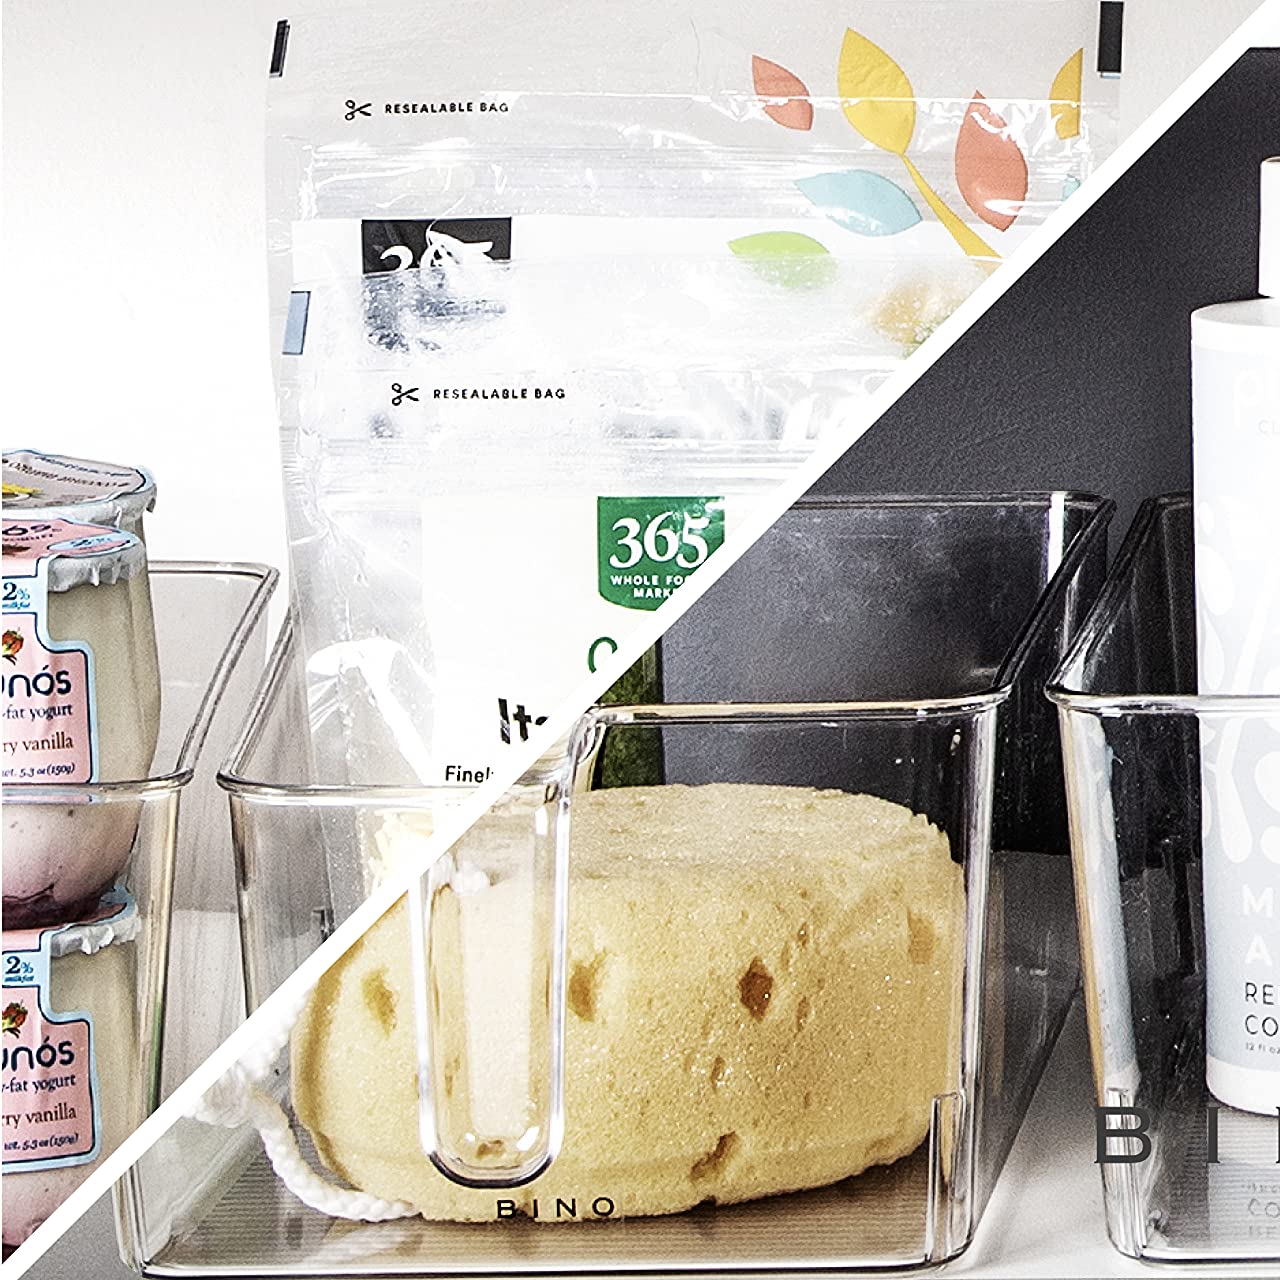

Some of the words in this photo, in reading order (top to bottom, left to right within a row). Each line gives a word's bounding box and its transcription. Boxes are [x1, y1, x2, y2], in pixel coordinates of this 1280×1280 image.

[385, 102, 473, 114] RESEALABLE
[480, 102, 509, 113] BAG
[433, 388, 528, 400] RESEALABLE
[534, 388, 566, 399] BAG
[607, 511, 712, 570] 365
[610, 574, 659, 587] WHOLE
[30, 704, 73, 721] yogurt
[22, 731, 75, 751] vanilla
[444, 765, 495, 783] Finel
[5, 955, 34, 975] 2%
[32, 1075, 76, 1094] yogurt
[25, 1102, 77, 1125] vanilla
[496, 1196, 615, 1219] BINO
